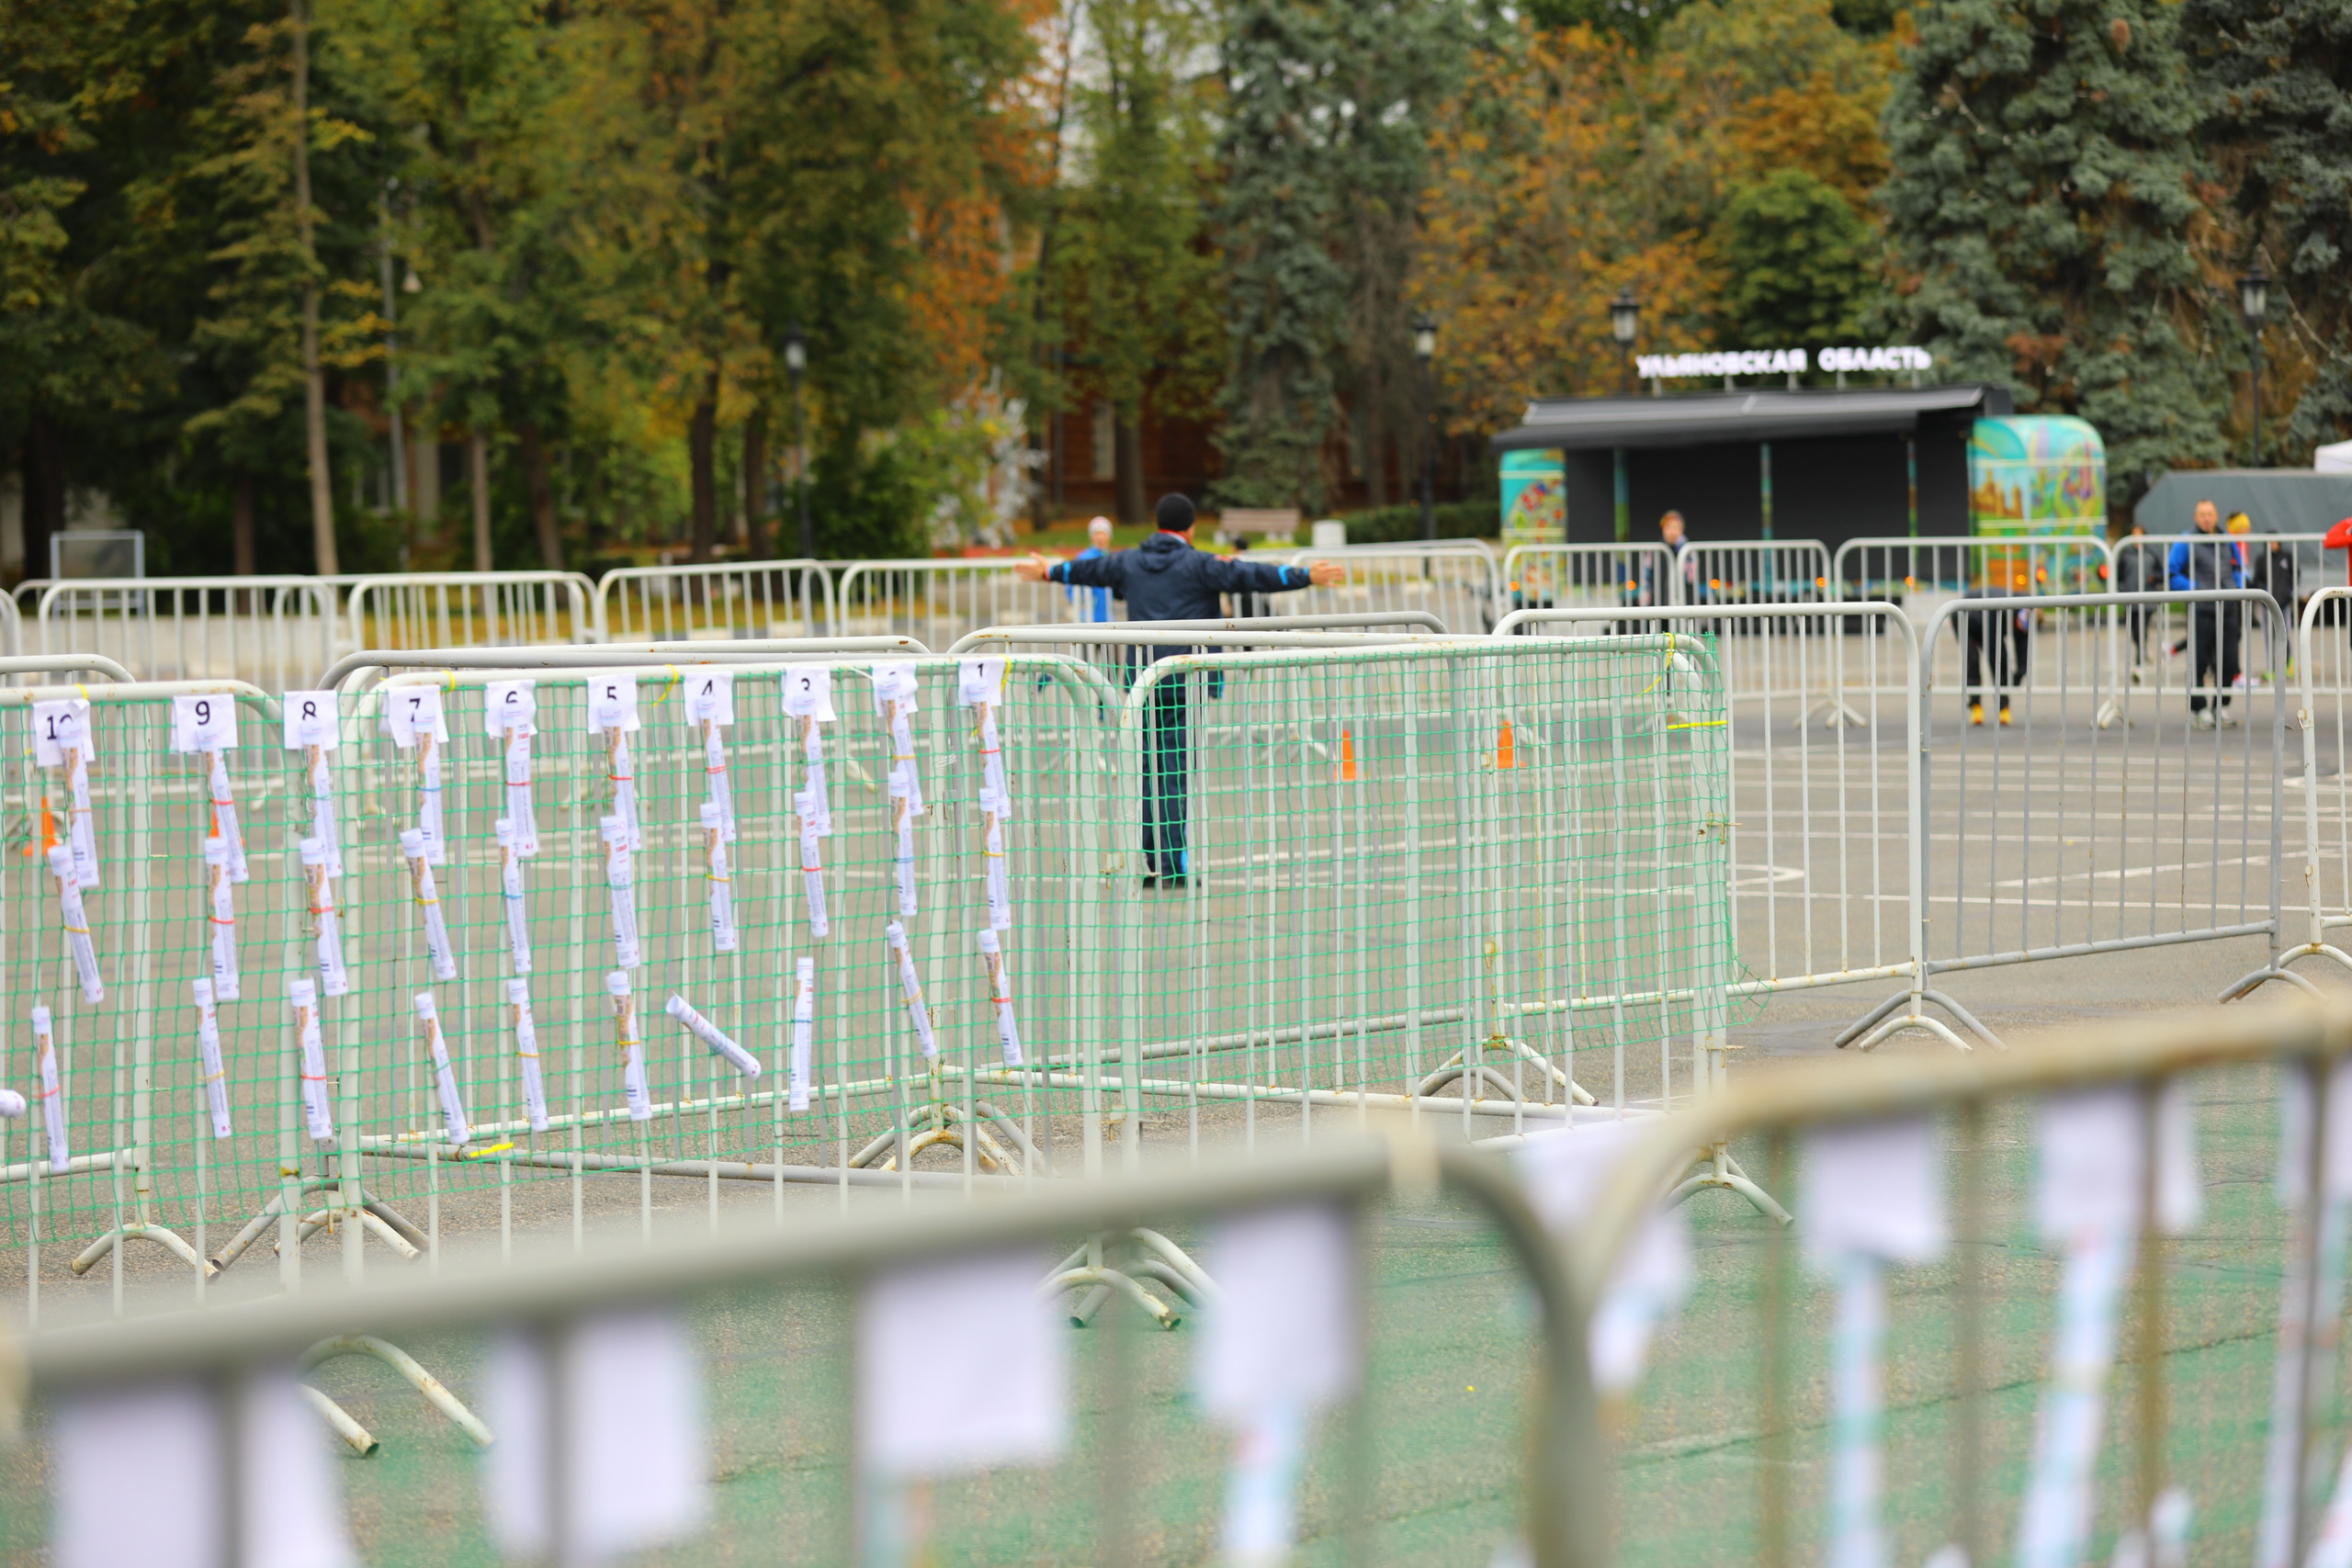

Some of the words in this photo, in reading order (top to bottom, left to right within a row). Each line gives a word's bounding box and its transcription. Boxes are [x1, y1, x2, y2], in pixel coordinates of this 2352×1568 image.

[1635, 348, 1807, 379] УЛЬЯНОВСКАЯ
[1817, 345, 1934, 373] ОБЛАСТЬ
[195, 700, 210, 726] 9
[409, 698, 421, 723] 7
